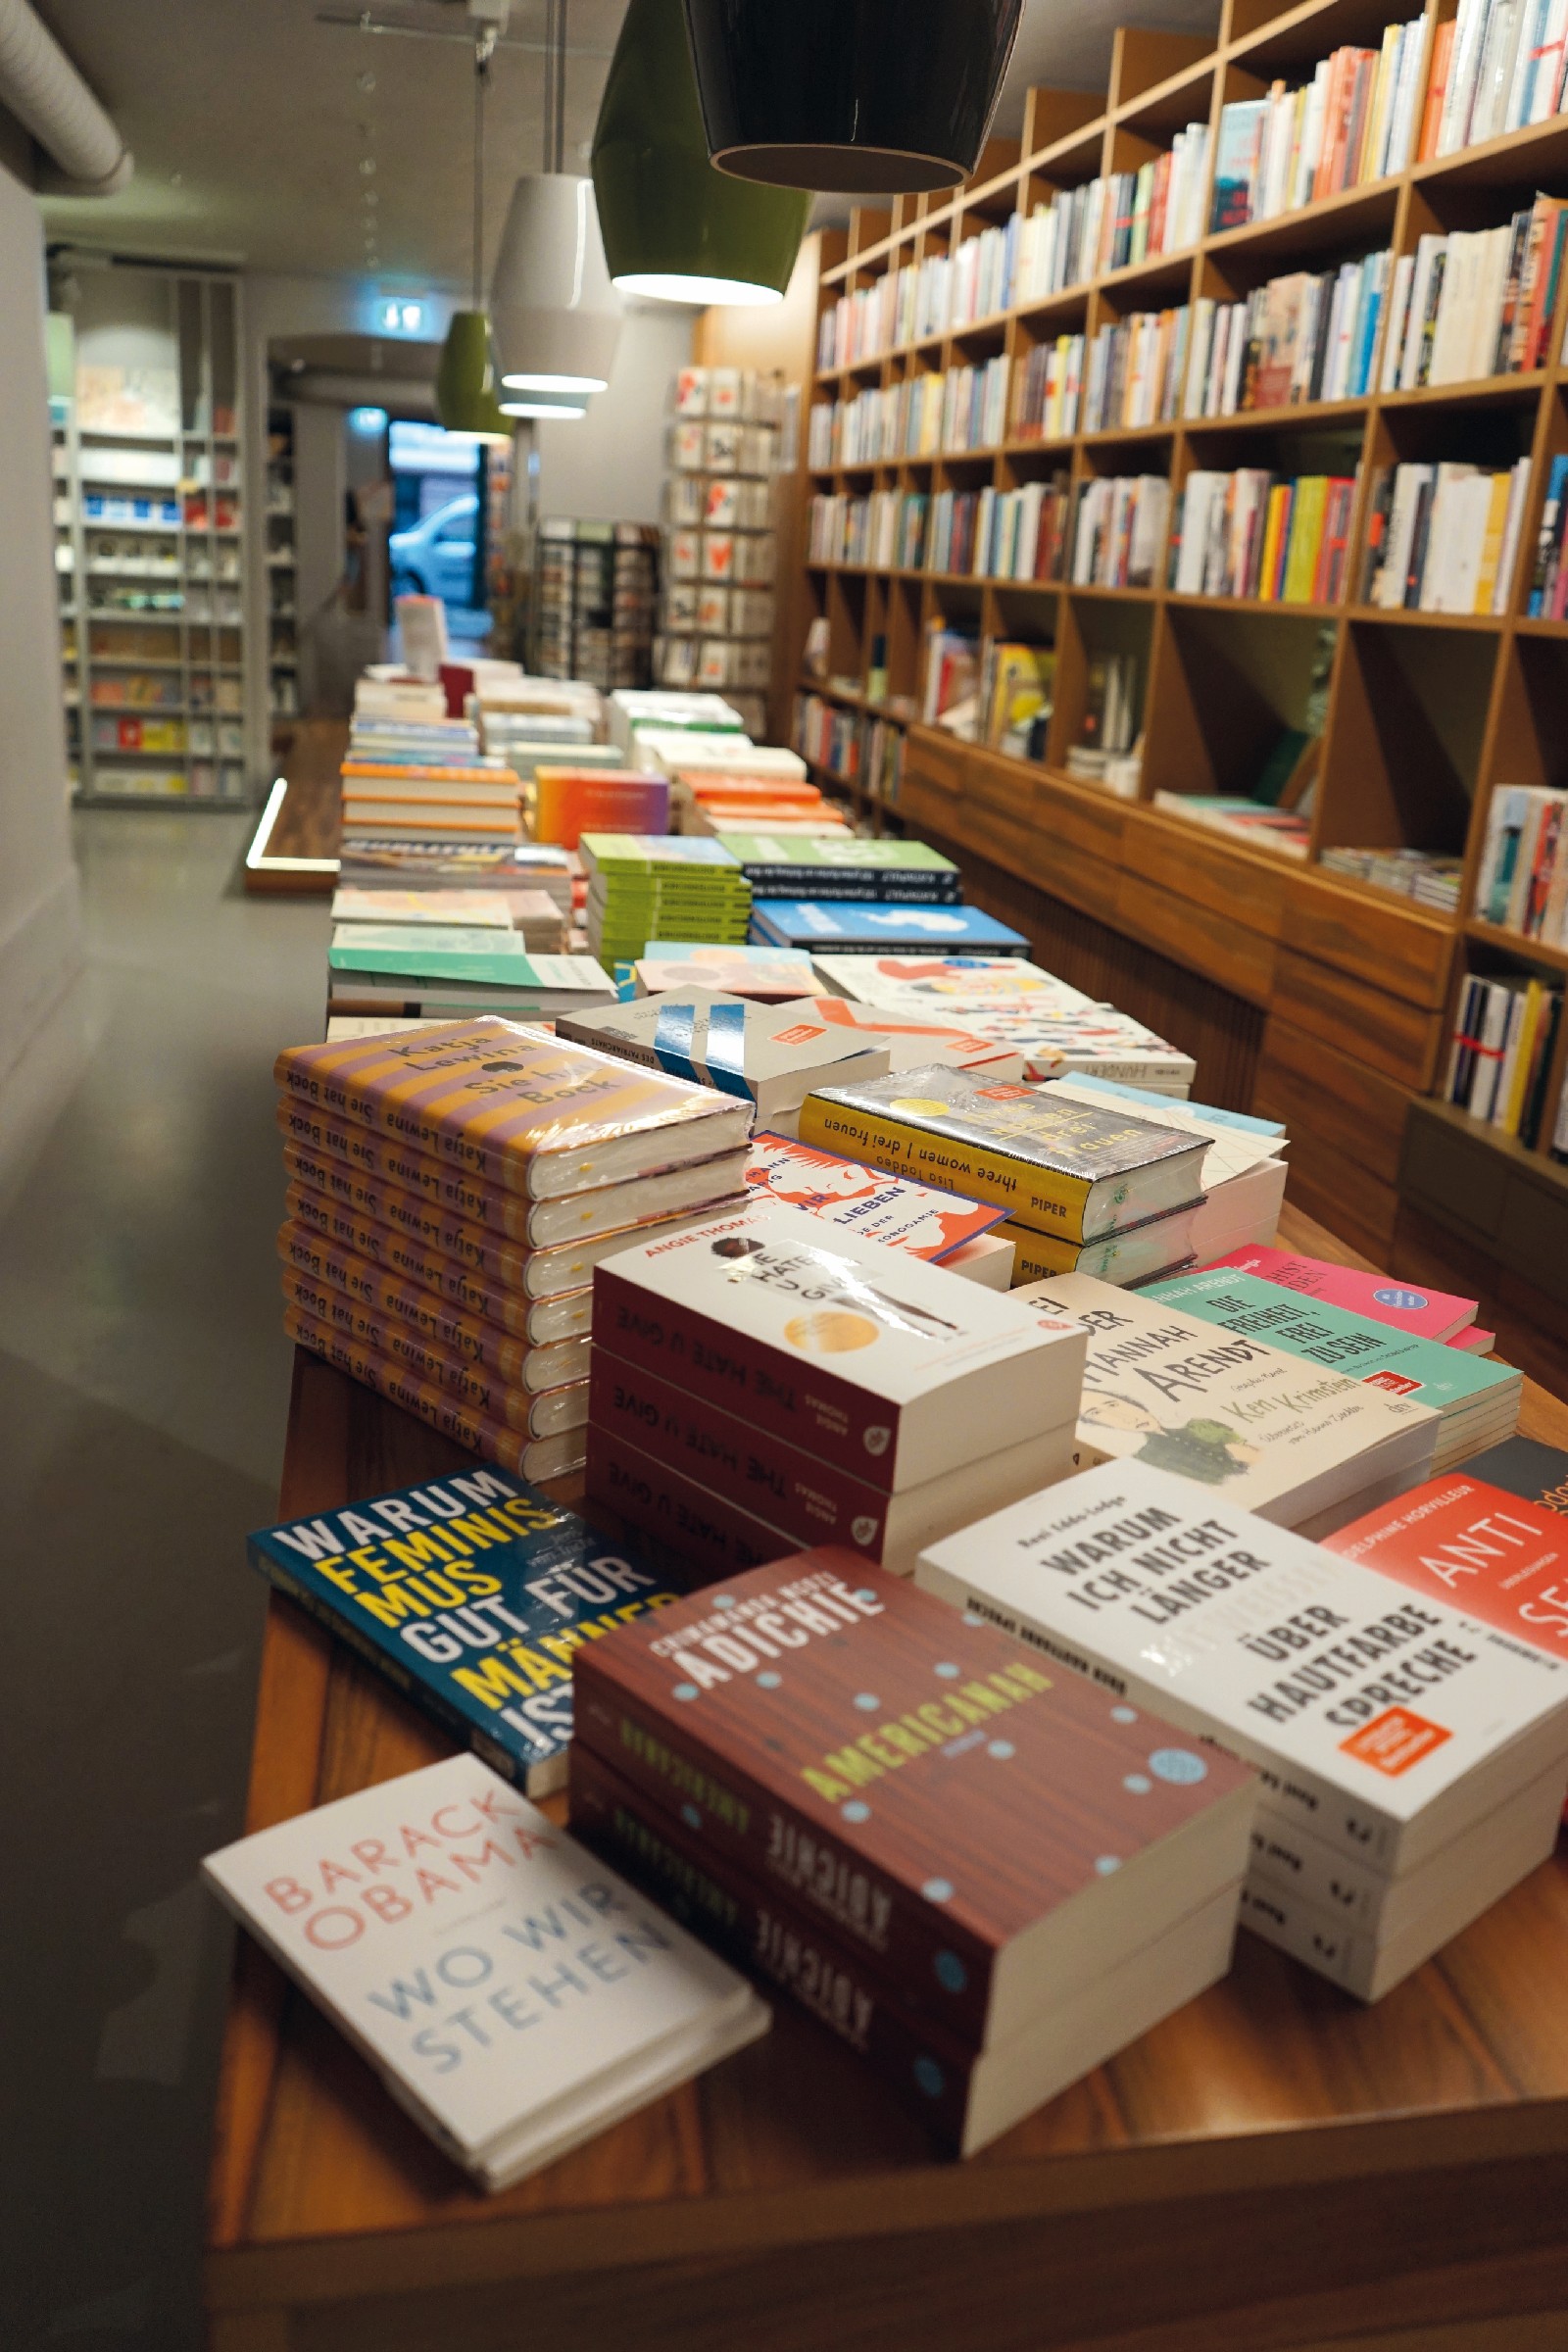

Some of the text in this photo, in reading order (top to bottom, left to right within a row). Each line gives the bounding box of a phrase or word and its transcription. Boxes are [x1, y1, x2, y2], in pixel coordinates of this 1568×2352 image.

[387, 1036, 492, 1058] Katja
[404, 1044, 537, 1072] Lewina
[591, 1037, 638, 1061] PATRIARCHATS
[465, 1077, 531, 1096] Sie
[517, 1079, 620, 1104] Bock
[286, 1070, 487, 1172] Katja Lewina Sie hat Bock
[1041, 1121, 1097, 1141] drei
[289, 1113, 487, 1219] Katja Lewina Sie hat Bock
[824, 1118, 1016, 1192] three women drei frauen
[876, 1156, 955, 1191] Lisa Taddeo
[295, 1156, 486, 1267] Katja Lewina Sie hat Bock
[833, 1187, 907, 1224] LIEBEN
[871, 1214, 895, 1228] DER
[1031, 1196, 1067, 1219] PIPER
[298, 1200, 488, 1317] Katja Lewina Sie hat Bock
[645, 1213, 772, 1259] ANGIE THOMAS
[752, 1256, 814, 1283] HATE
[776, 1279, 800, 1291] U
[1021, 1259, 1057, 1279] PIPER
[1192, 1274, 1246, 1292] ARENDT
[289, 1242, 484, 1363] Katja Lewina Sie hat Bock
[616, 1305, 663, 1347] GIVE
[1027, 1297, 1069, 1315] EI
[1205, 1296, 1256, 1313] DIE
[1217, 1303, 1320, 1336] FREIHEIT,
[295, 1284, 490, 1410] Katja Lewina Sie hat Bock
[1083, 1325, 1199, 1383] HANNAH
[1275, 1322, 1335, 1344] FREI
[1300, 1346, 1342, 1364] ZU
[1339, 1332, 1388, 1358] SEIN
[296, 1324, 484, 1452] Katja Lewina Sie hat Bock
[1133, 1339, 1272, 1403] ARENDT
[612, 1386, 659, 1426] GIVE
[1220, 1398, 1278, 1423] Ken
[1271, 1378, 1361, 1413] Krimstein
[271, 1470, 518, 1560] WARUM
[1018, 1528, 1052, 1548] Reni
[1040, 1506, 1183, 1576] WARUM
[314, 1497, 561, 1595] FEMINIS
[734, 1535, 763, 1568] HE
[1066, 1519, 1239, 1611] ICH NICHT
[1418, 1512, 1543, 1589] ANTI
[354, 1560, 503, 1628] MUS
[400, 1594, 530, 1663] GUT
[524, 1556, 657, 1617] FÜR
[1130, 1549, 1271, 1625] LÄNGER
[672, 1580, 884, 1690] ADICHIE
[1236, 1604, 1350, 1662] ÜBER
[1247, 1602, 1443, 1724] HAUTFARBE
[1324, 1639, 1478, 1728] SPRECHE
[500, 1683, 574, 1749] IS
[801, 1662, 1054, 1803] AMERICANAH
[264, 1789, 520, 1916] BARACK
[304, 1826, 559, 1951] OBAMA
[368, 1882, 626, 2021] WO WIR
[411, 1919, 676, 2075] STEHEN
